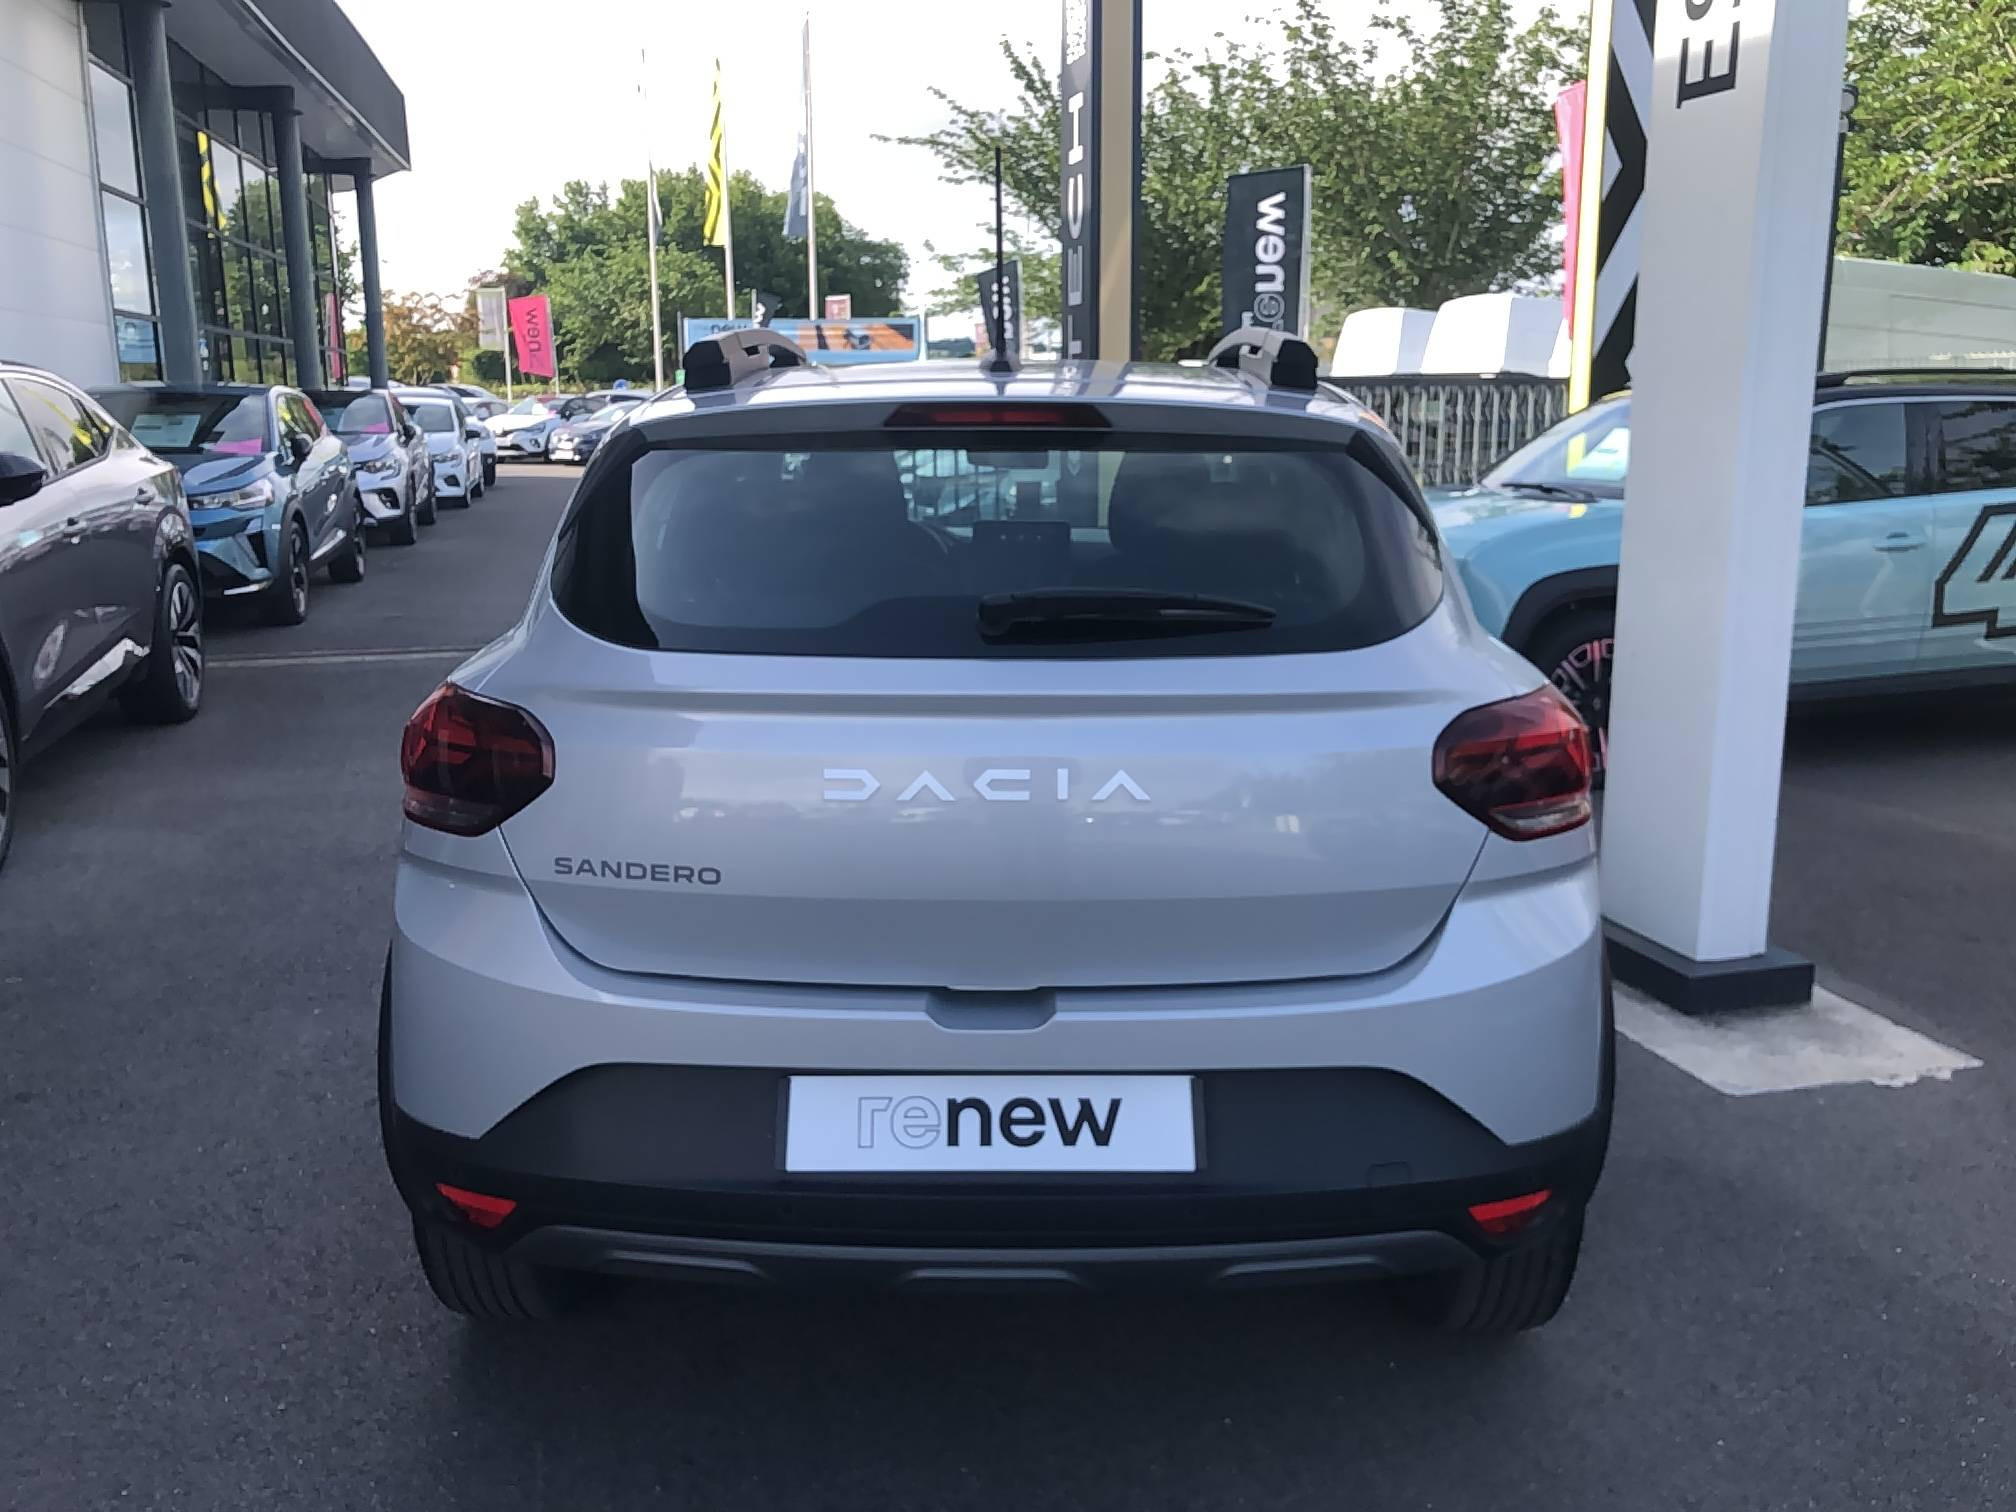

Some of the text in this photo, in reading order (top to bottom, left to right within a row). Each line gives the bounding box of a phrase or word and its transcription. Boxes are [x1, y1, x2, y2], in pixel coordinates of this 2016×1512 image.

[822, 768, 1151, 801] DACIA
[554, 856, 722, 886] SANDERO
[857, 1096, 1122, 1149] renew
